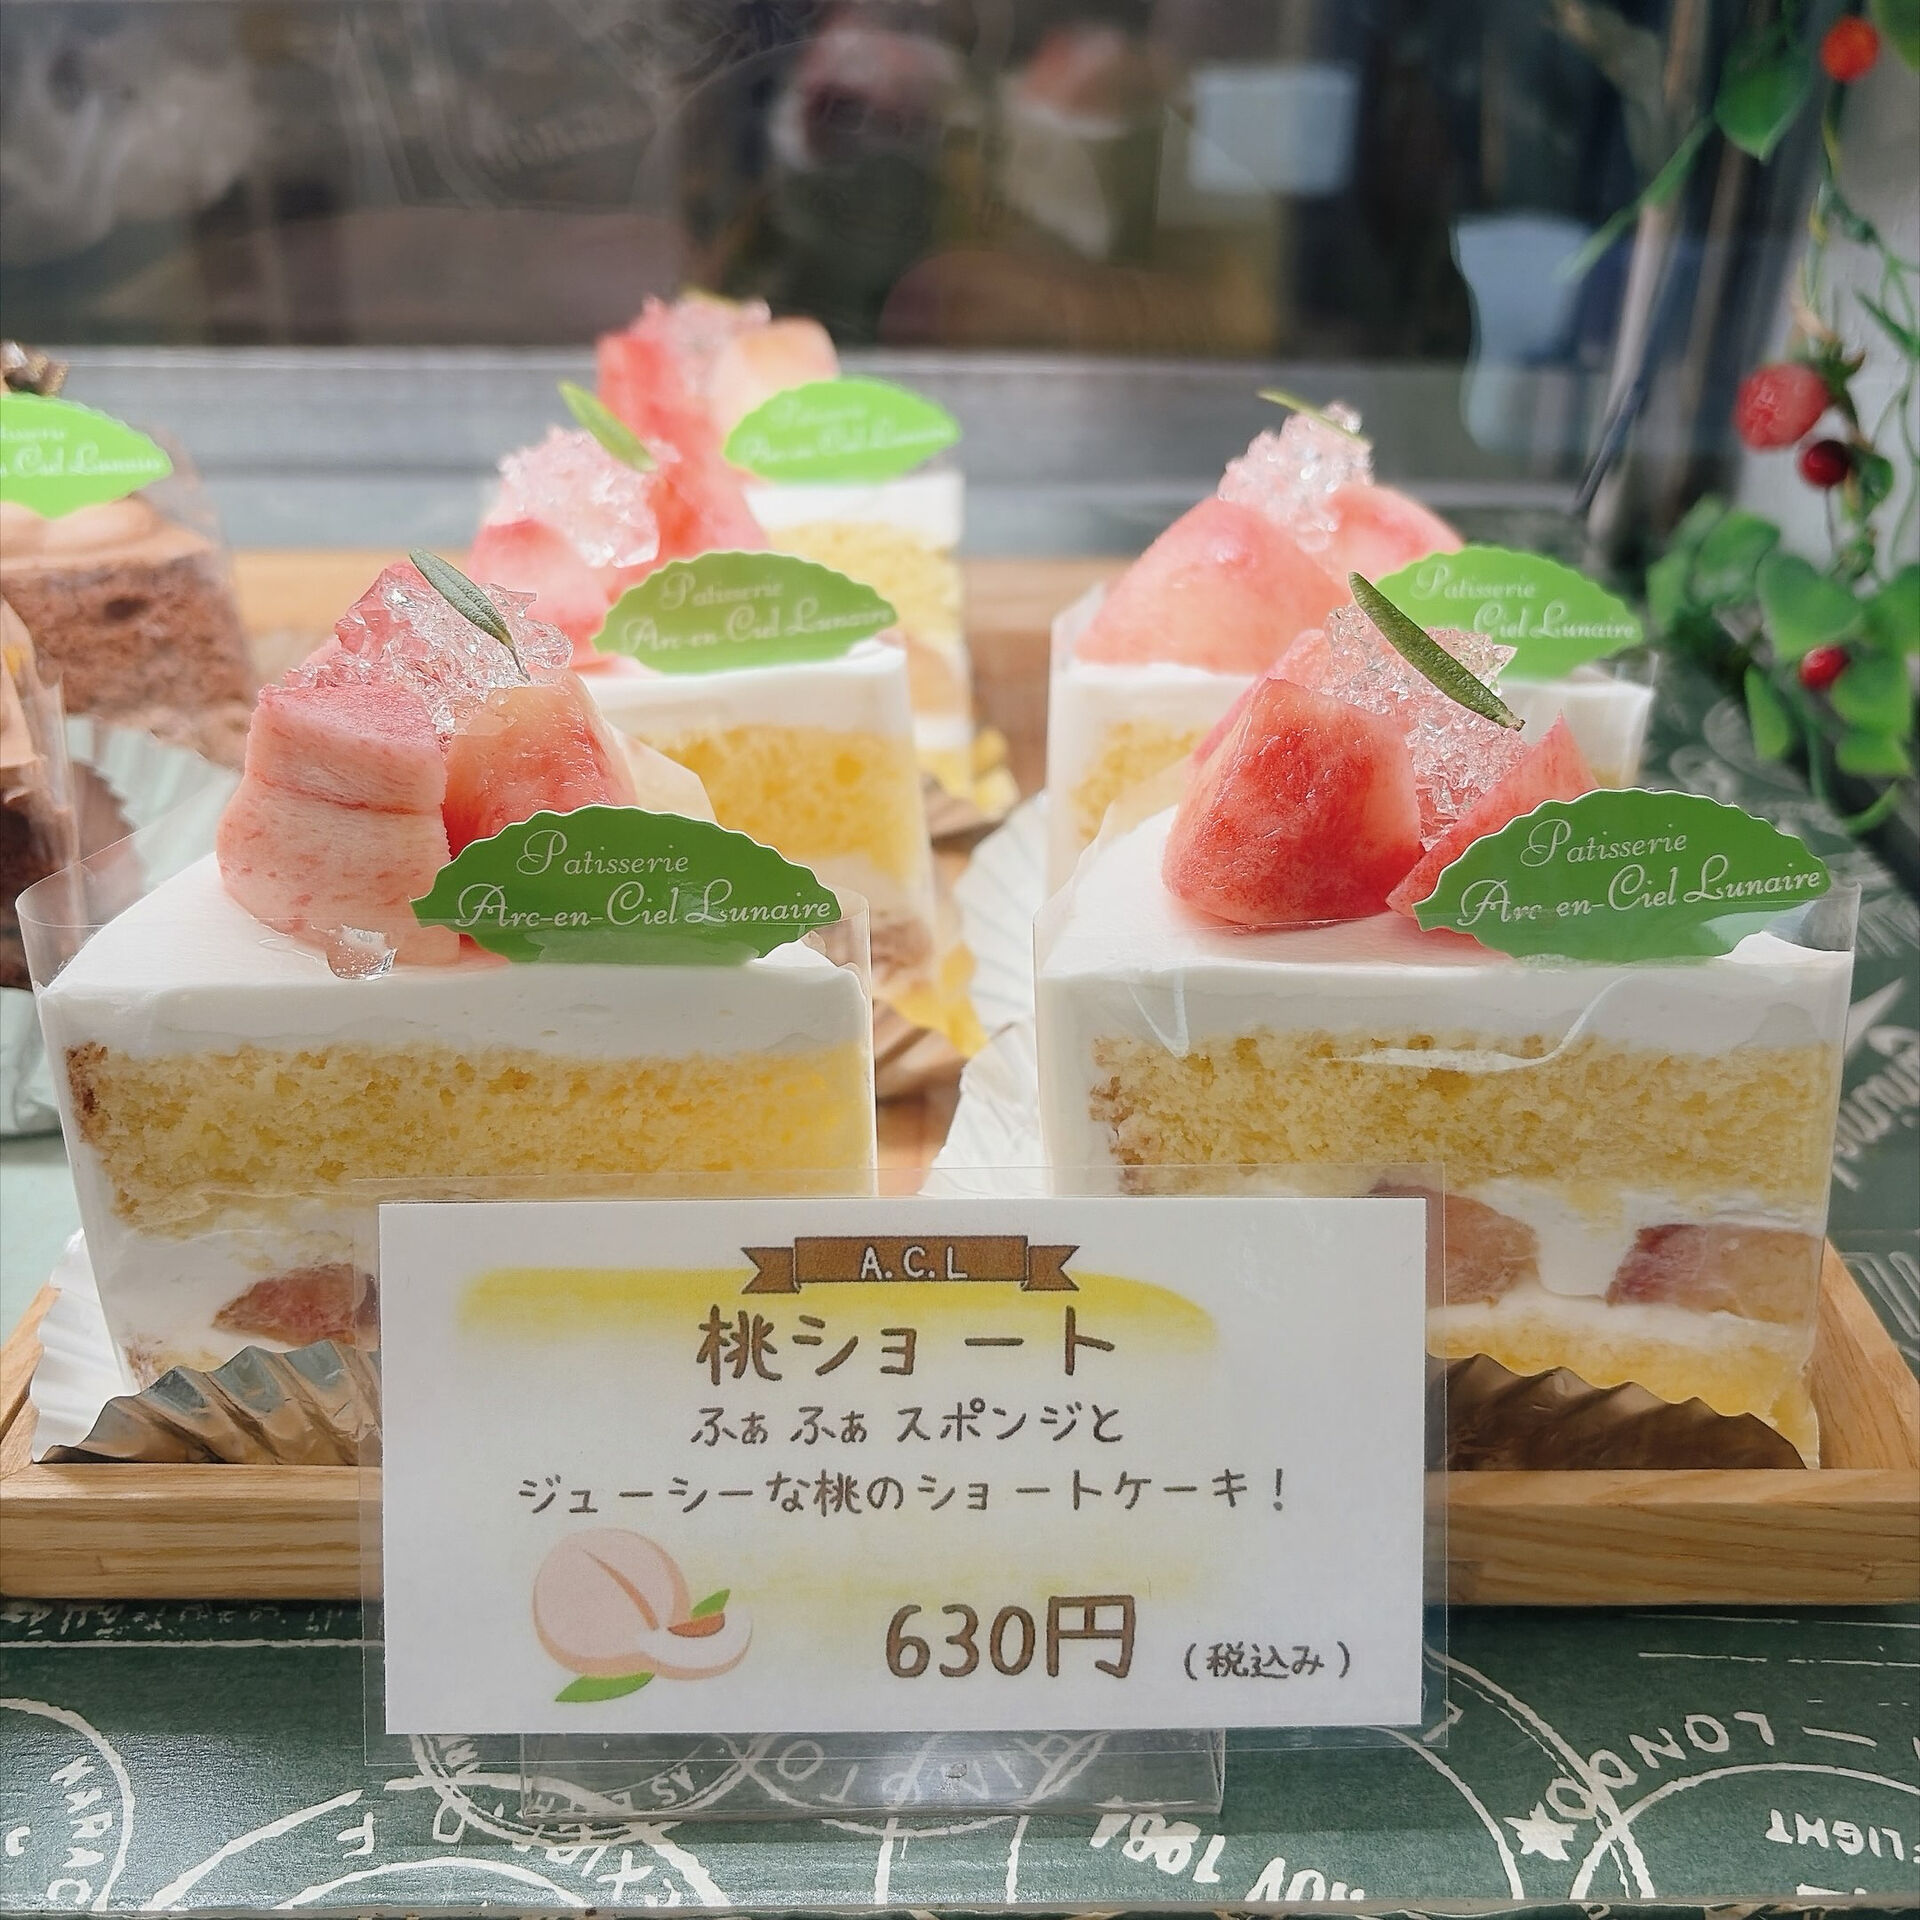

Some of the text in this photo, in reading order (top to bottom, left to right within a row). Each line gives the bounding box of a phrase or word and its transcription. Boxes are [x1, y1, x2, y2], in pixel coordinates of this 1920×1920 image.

[515, 828, 690, 876] Patisserie
[1519, 818, 1688, 868] Patisserie
[685, 878, 832, 925] Lunaire
[1682, 853, 1821, 905] Lunaire
[696, 1306, 1115, 1387] 桃ショート
[884, 1594, 1137, 1681] 630円
